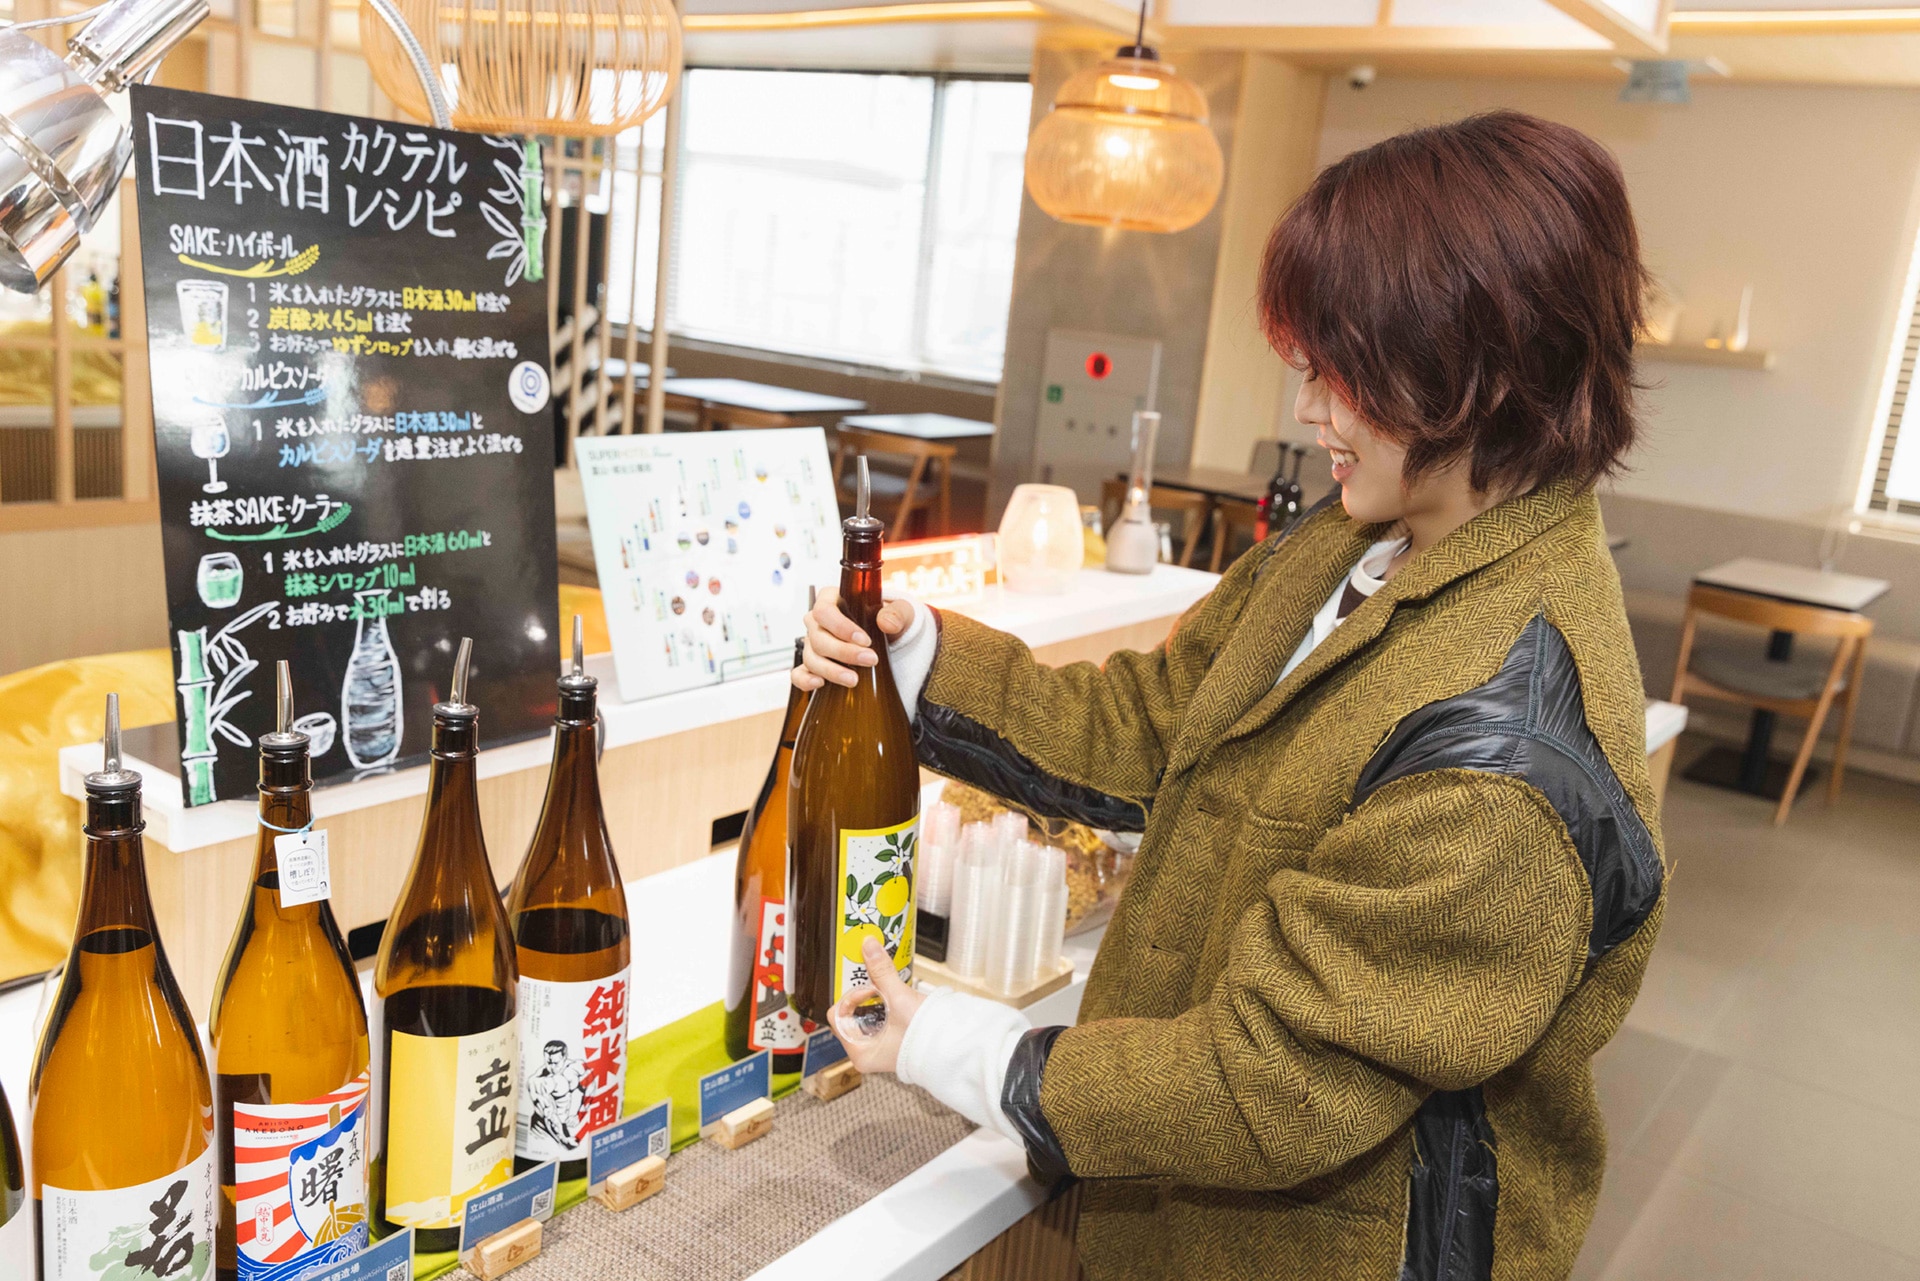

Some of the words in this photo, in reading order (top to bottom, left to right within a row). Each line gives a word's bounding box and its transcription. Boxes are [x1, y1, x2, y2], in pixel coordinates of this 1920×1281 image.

[146, 112, 330, 214] 日本酒
[340, 121, 468, 184] カクテル
[345, 184, 463, 238] レシピ
[247, 281, 256, 303] 1
[246, 308, 260, 329] 2
[252, 418, 263, 441] 1
[263, 551, 274, 574] 1
[284, 561, 416, 597] 抹茶シロップ10ml
[267, 609, 281, 630] 2
[761, 1017, 776, 1041] 立山
[574, 979, 626, 1146] 純米酒
[464, 1057, 512, 1156] 立山
[245, 1124, 304, 1134] AKEBONO
